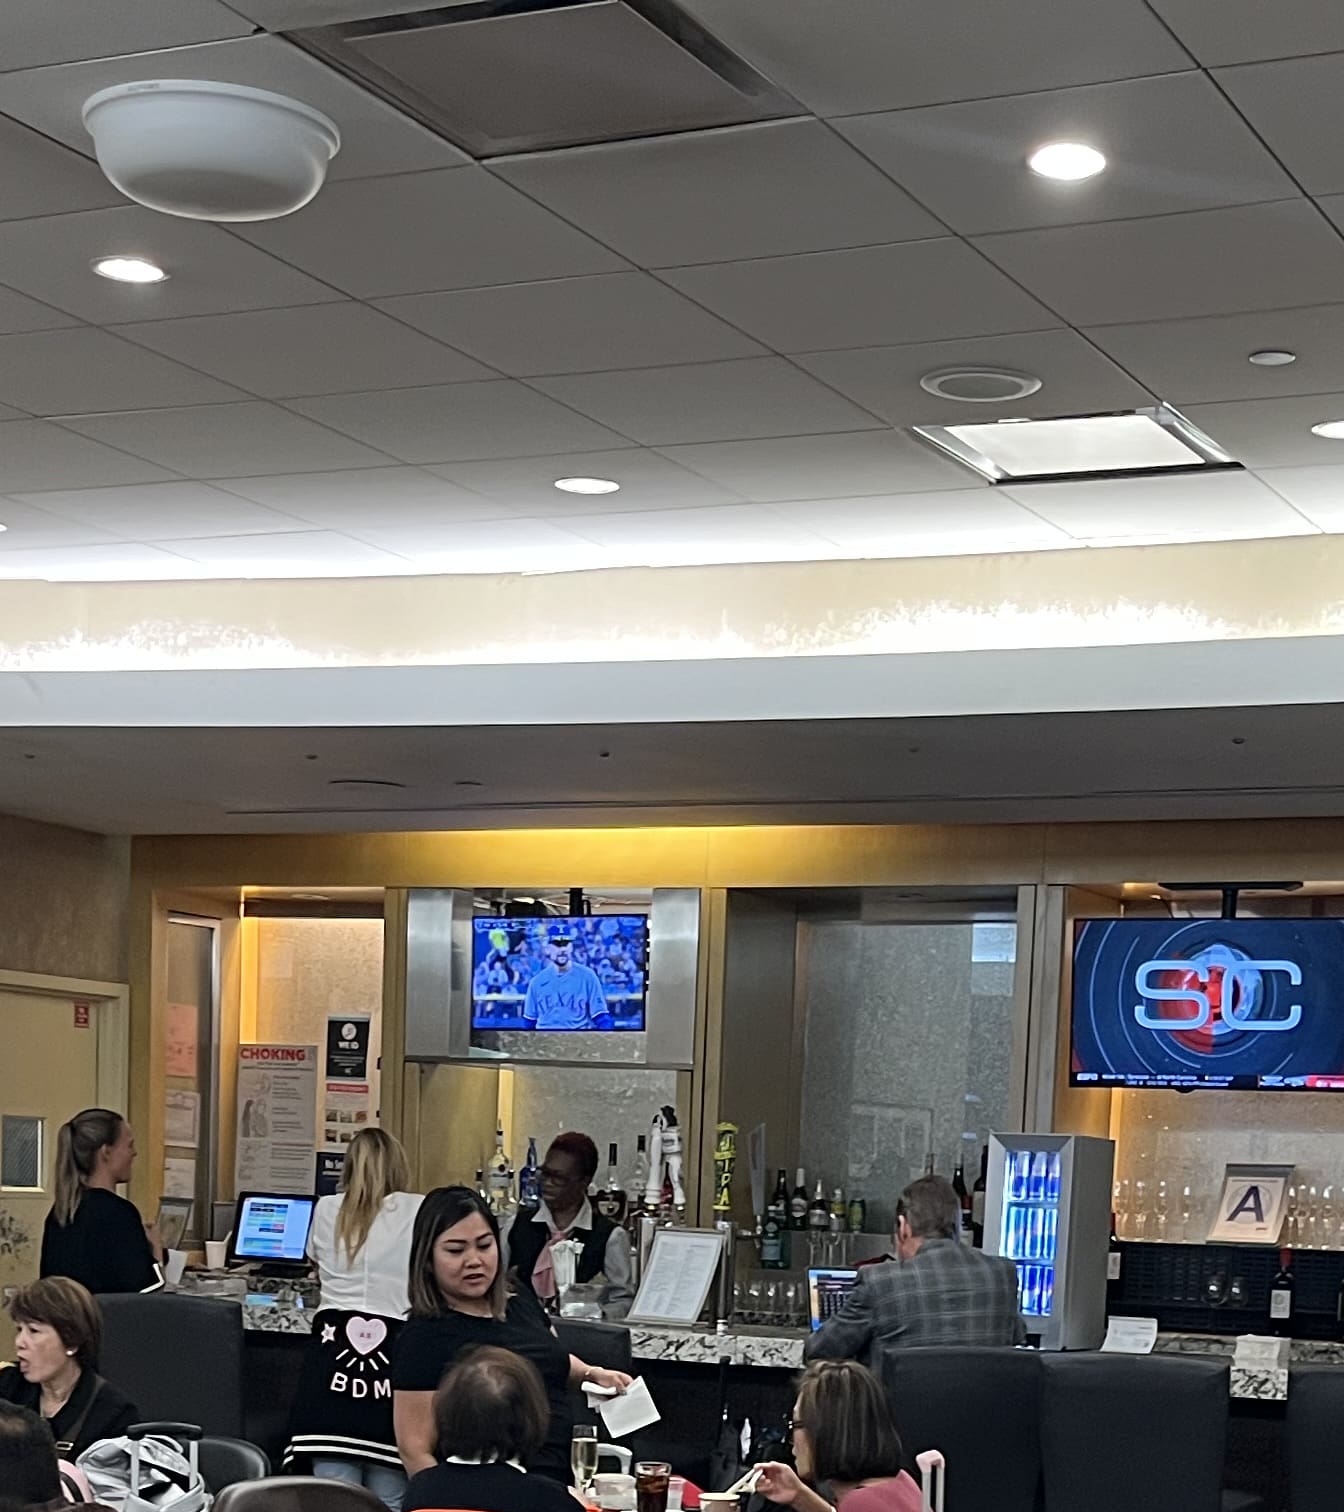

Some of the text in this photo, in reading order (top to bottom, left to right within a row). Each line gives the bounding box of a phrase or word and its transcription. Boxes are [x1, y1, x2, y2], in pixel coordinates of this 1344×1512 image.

[1134, 960, 1302, 1031] SC
[240, 1047, 305, 1062] CHOKING
[1226, 1185, 1264, 1223] A
[330, 1372, 391, 1399] BDM
